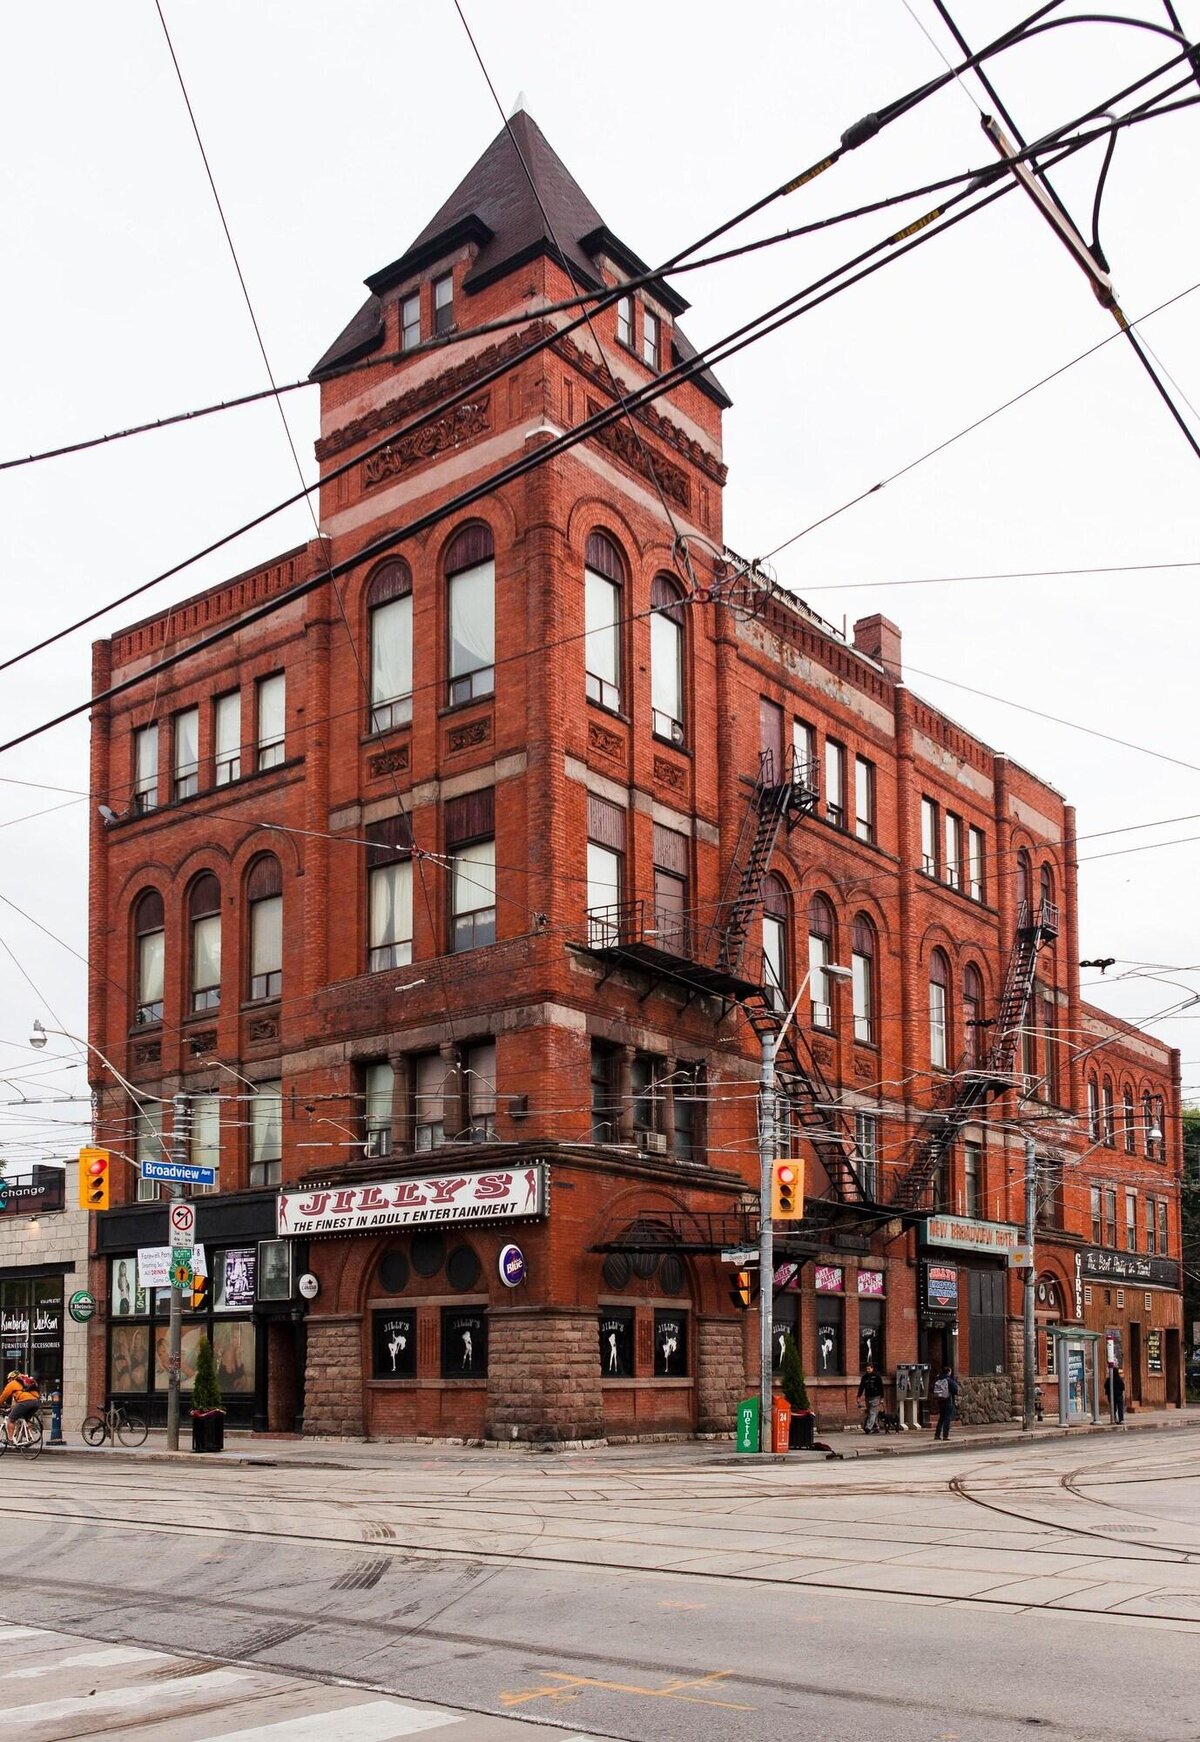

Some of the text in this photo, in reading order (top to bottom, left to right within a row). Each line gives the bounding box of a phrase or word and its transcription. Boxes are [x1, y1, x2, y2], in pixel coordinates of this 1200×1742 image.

[145, 1163, 199, 1179] Broadview
[1, 1187, 45, 1197] change
[299, 1173, 513, 1216] JILLY'S
[294, 1202, 518, 1232] THE FINEST IN ADULT ENTERTAINMENT
[951, 1223, 993, 1245] BROADVIEW
[174, 1250, 192, 1259] NORTH
[507, 1258, 522, 1274] Blue
[929, 1288, 957, 1298] DANCING
[384, 1321, 410, 1332] JILLY'S
[780, 1413, 787, 1421] 24
